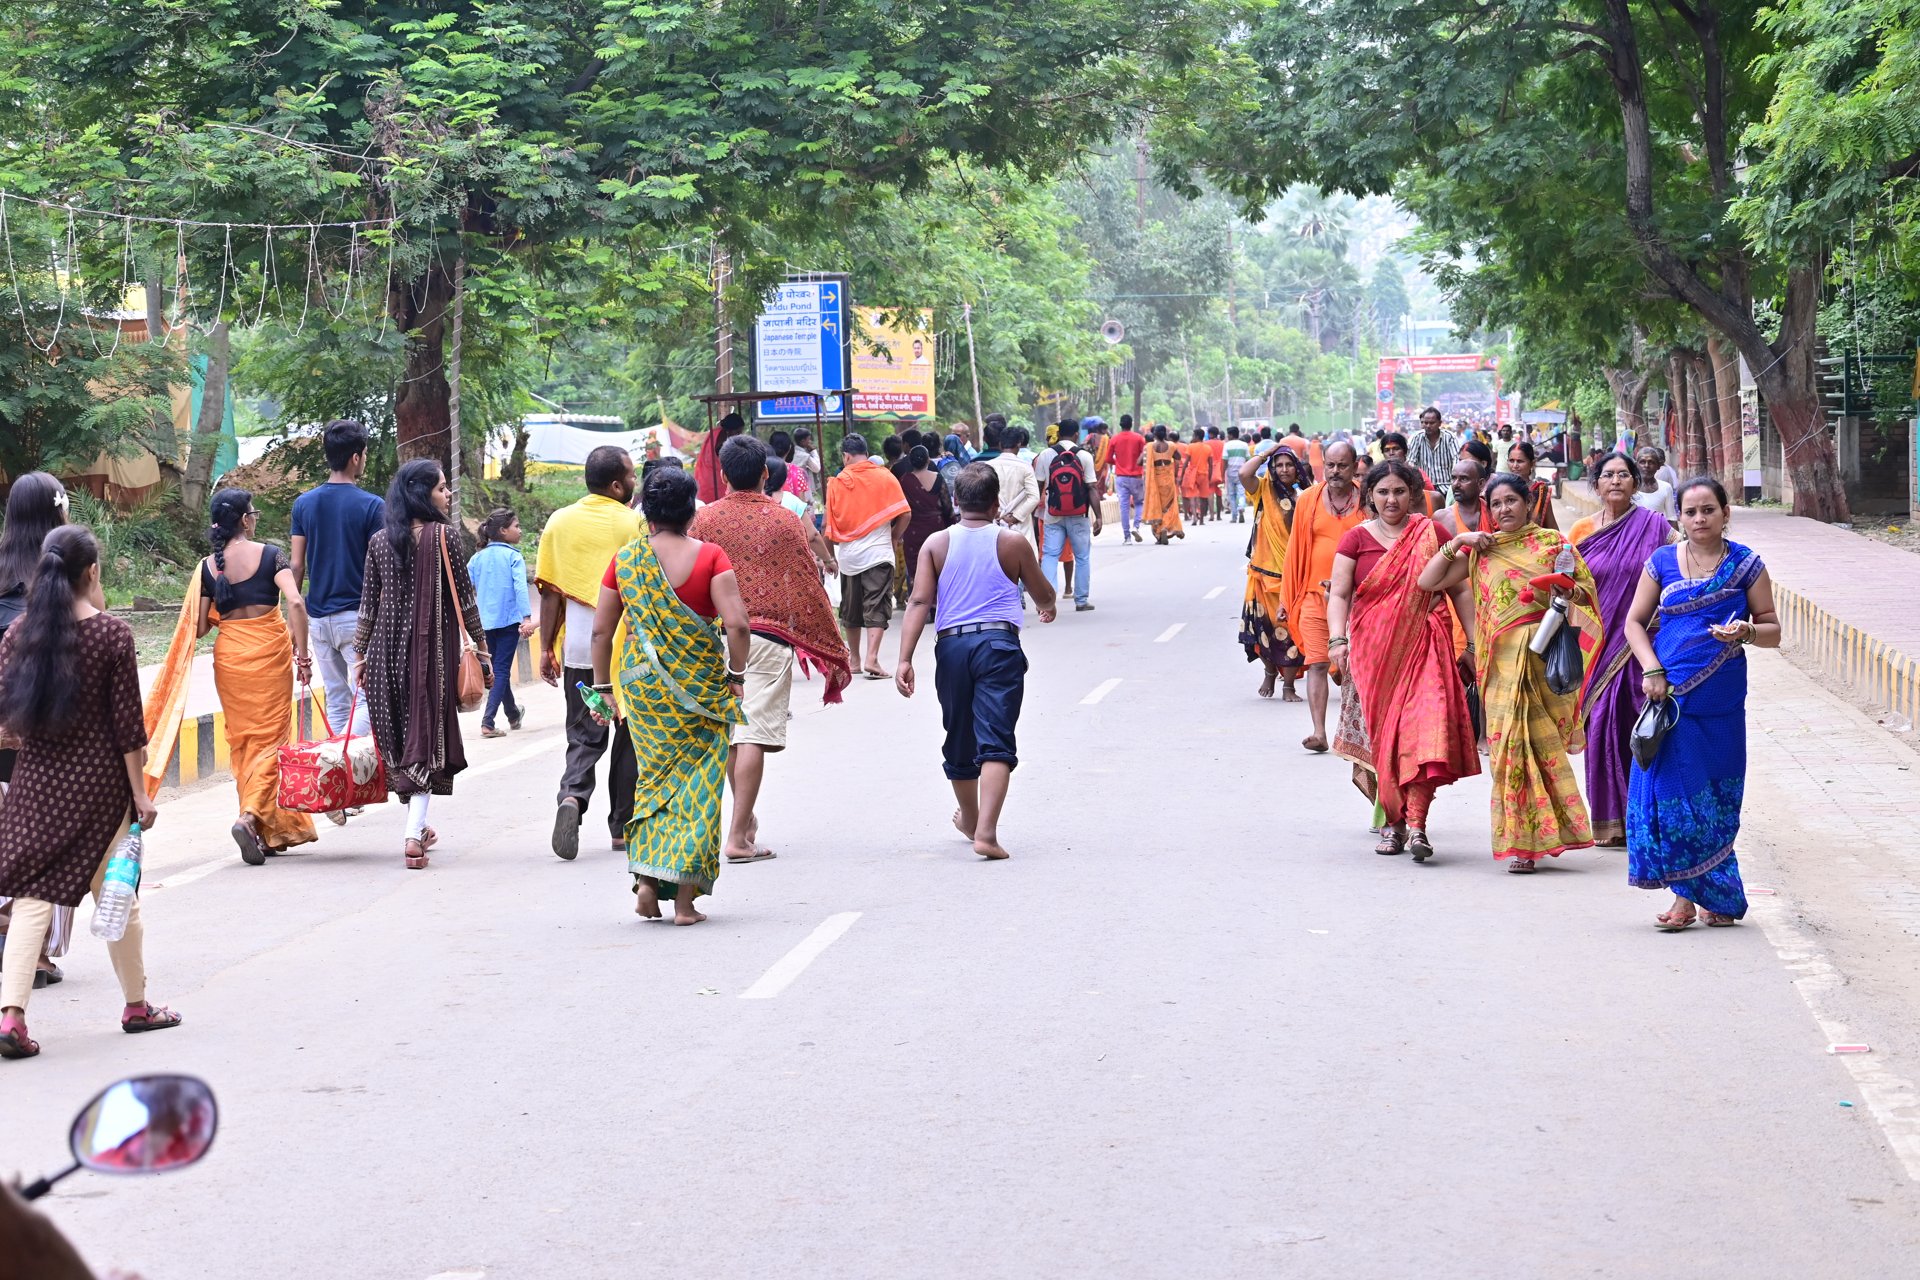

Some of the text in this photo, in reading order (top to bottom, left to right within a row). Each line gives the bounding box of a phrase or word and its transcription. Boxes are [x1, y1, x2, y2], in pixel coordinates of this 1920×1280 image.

[786, 289, 811, 298] पोखर
[790, 302, 812, 310] Pond
[762, 316, 793, 327] जापानी
[763, 332, 817, 342] Japanese Temple
[775, 395, 816, 405] BIHAR
